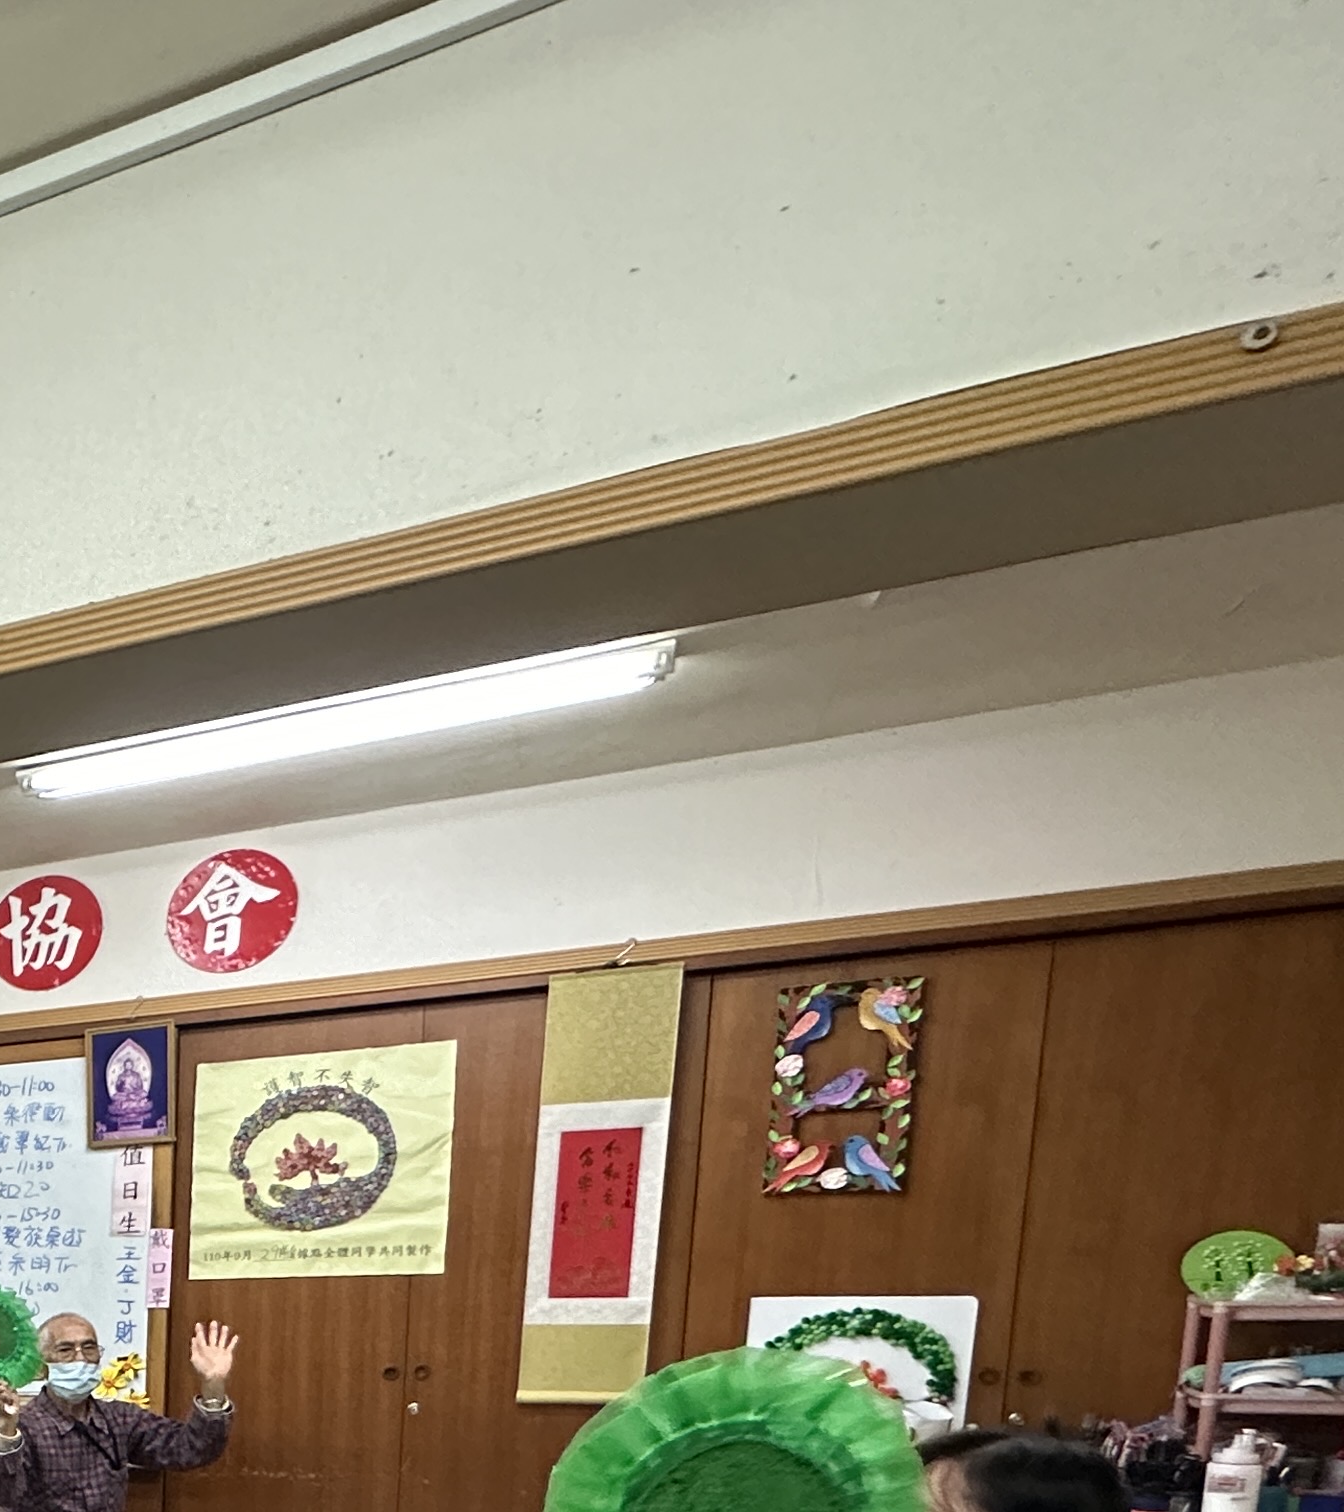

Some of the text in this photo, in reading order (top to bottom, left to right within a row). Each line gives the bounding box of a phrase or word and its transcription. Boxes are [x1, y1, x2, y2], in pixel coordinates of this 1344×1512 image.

[117, 1145, 146, 1235] 值日生
[149, 1229, 170, 1307] 戴口罩
